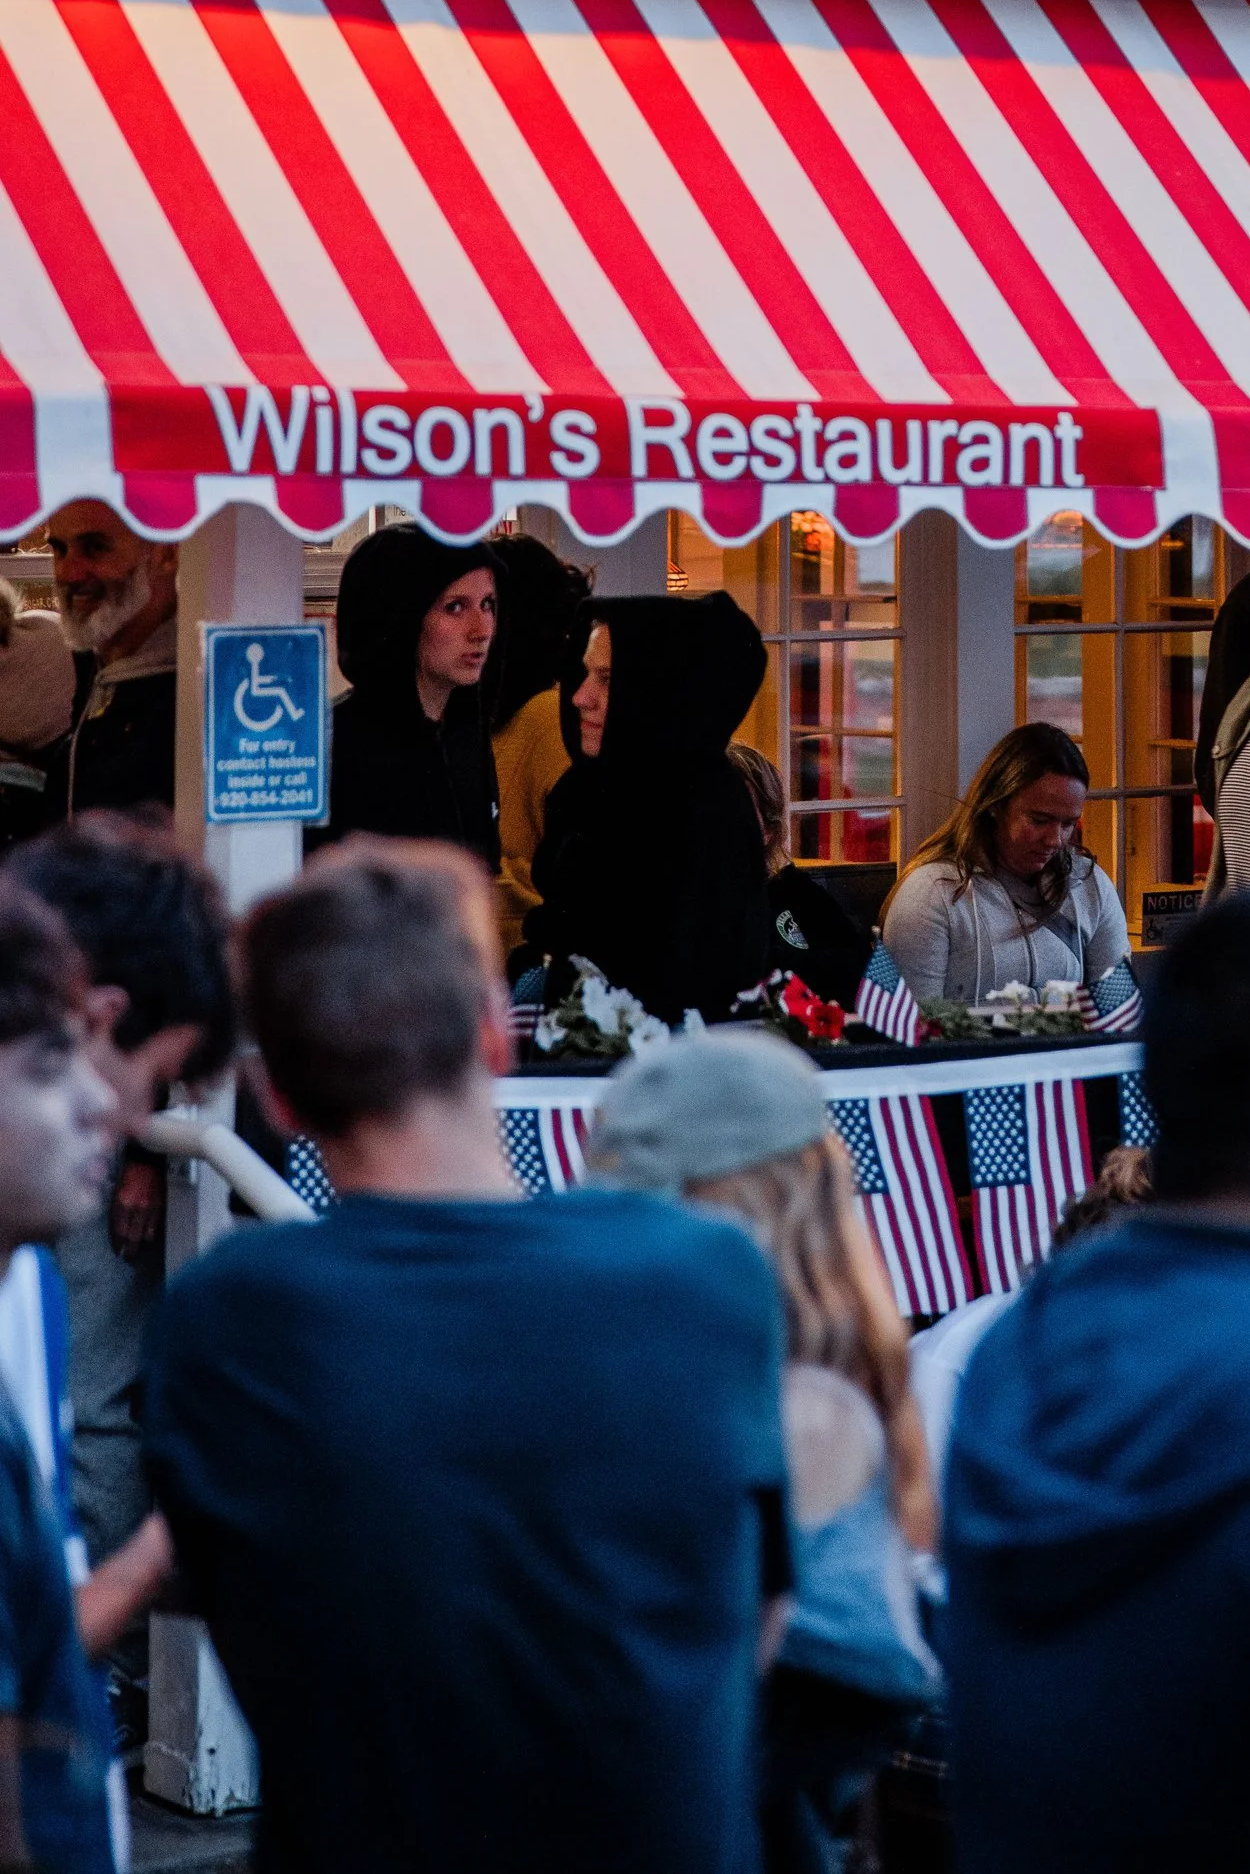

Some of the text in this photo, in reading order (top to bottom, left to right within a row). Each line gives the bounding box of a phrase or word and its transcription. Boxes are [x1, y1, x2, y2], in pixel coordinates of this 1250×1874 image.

[203, 384, 1086, 489] Wilson's Restaurant
[239, 737, 296, 755] For entry
[216, 757, 266, 771] contact
[228, 771, 308, 788] inside or call
